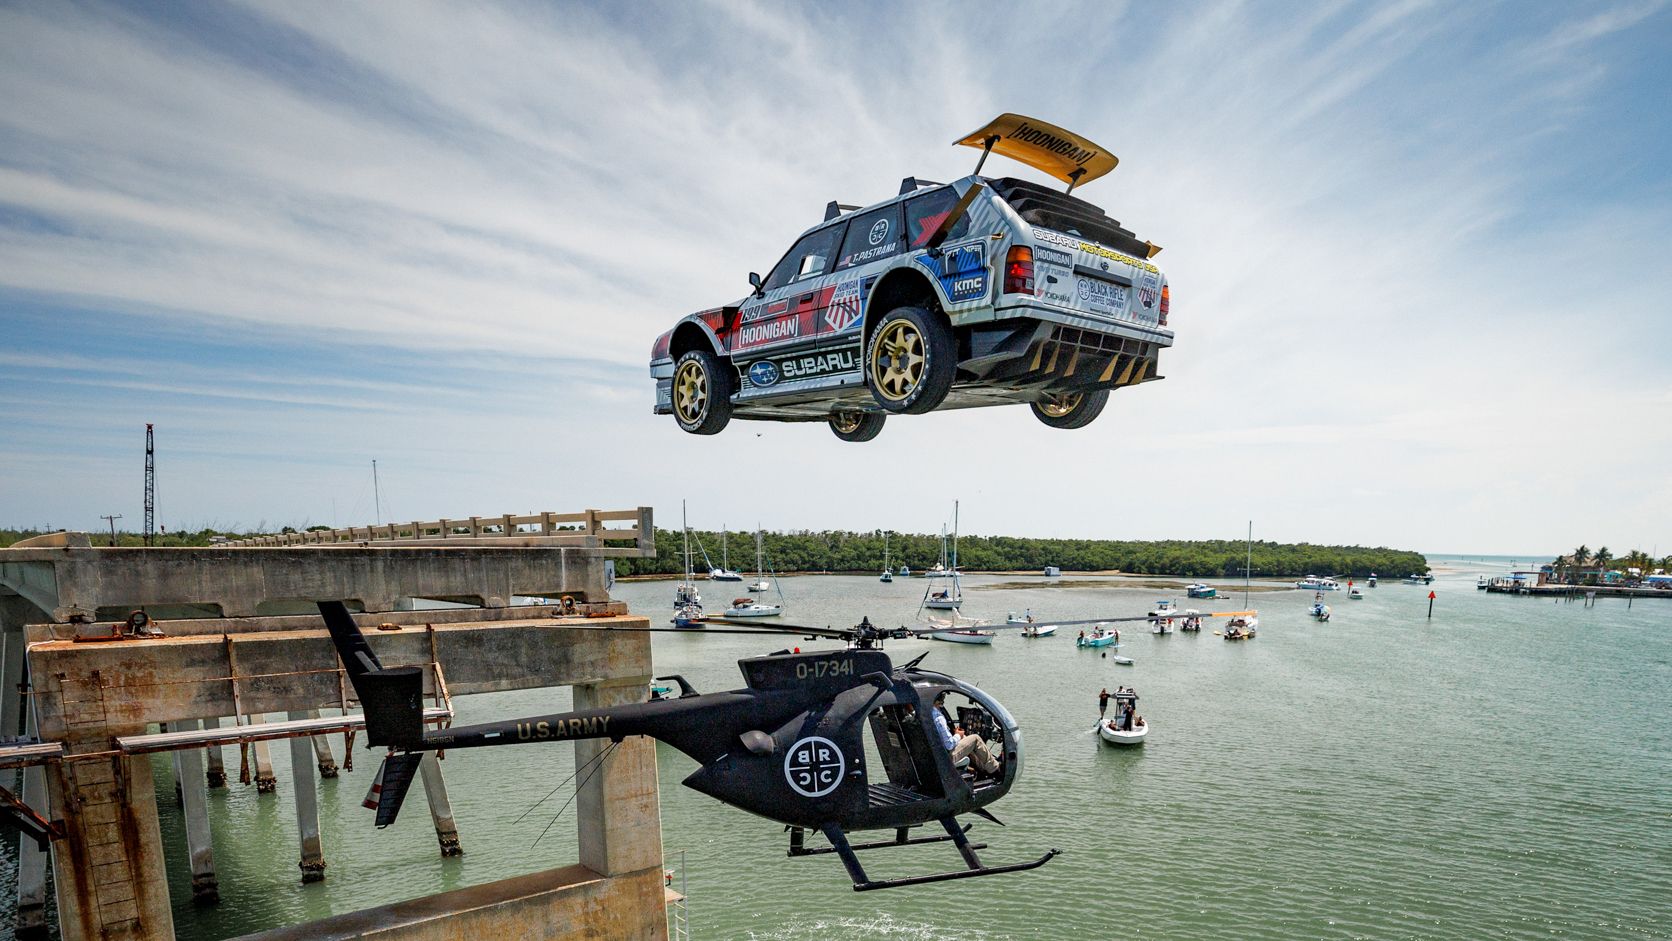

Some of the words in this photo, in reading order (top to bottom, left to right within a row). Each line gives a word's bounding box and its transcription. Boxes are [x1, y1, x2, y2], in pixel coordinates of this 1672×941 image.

[1033, 229, 1078, 250] SUBARU
[1090, 281, 1108, 298] BLACK
[1108, 285, 1124, 301] RIFLE
[1090, 294, 1105, 305] COFFEE
[1106, 298, 1124, 309] COMPANY
[782, 351, 853, 377] SUBARU
